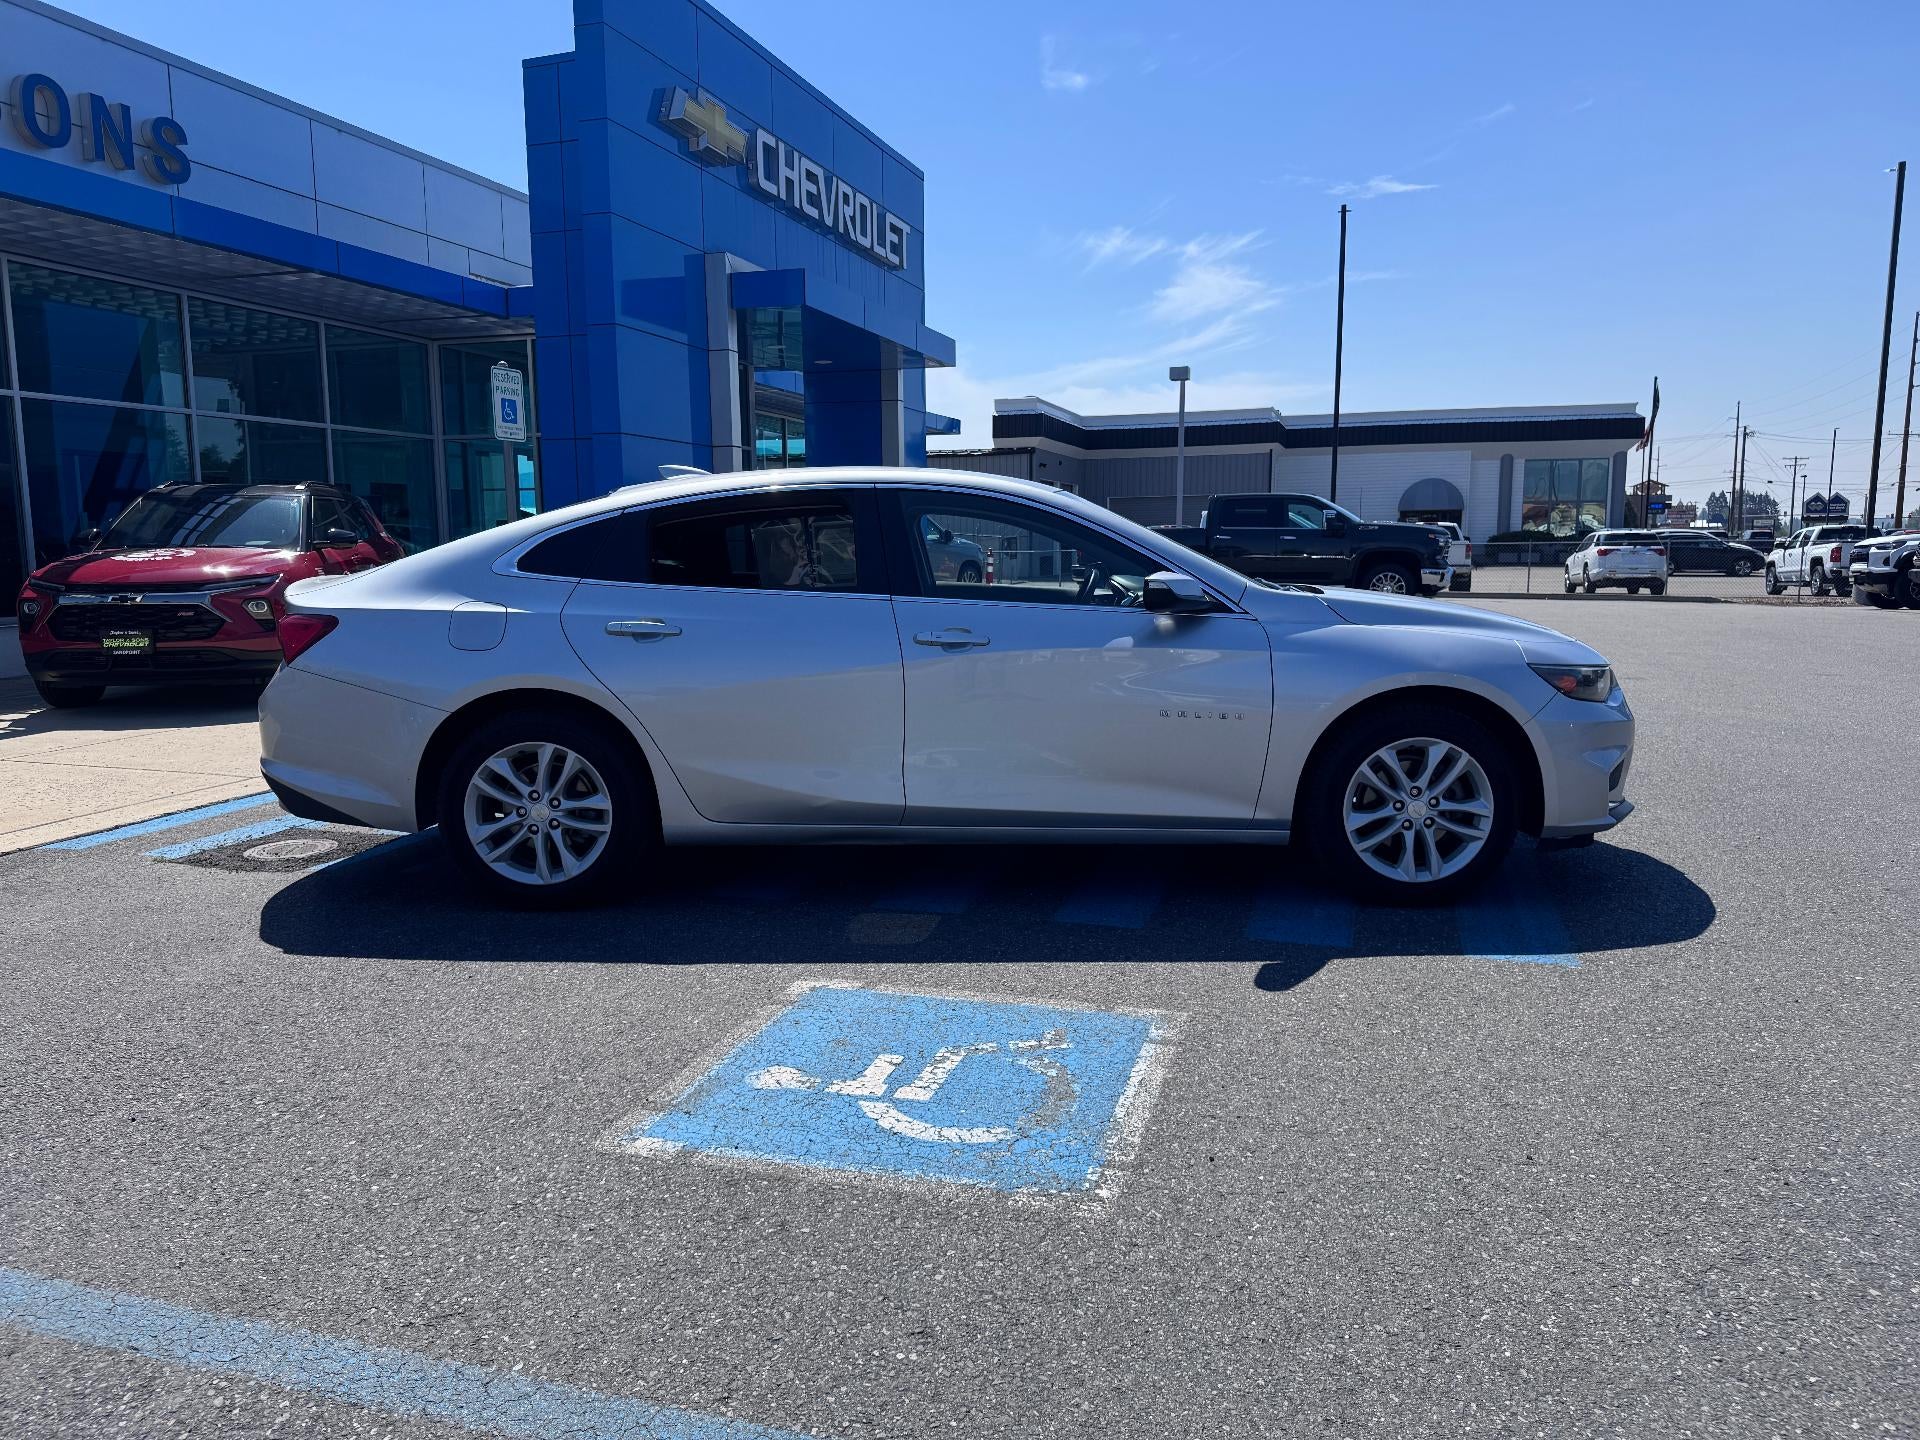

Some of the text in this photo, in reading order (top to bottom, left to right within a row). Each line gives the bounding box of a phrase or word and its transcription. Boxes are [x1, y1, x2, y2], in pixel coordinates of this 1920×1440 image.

[756, 128, 911, 270] CHEVROLET
[493, 372, 520, 385] RESERVED
[495, 385, 520, 398] PARKING
